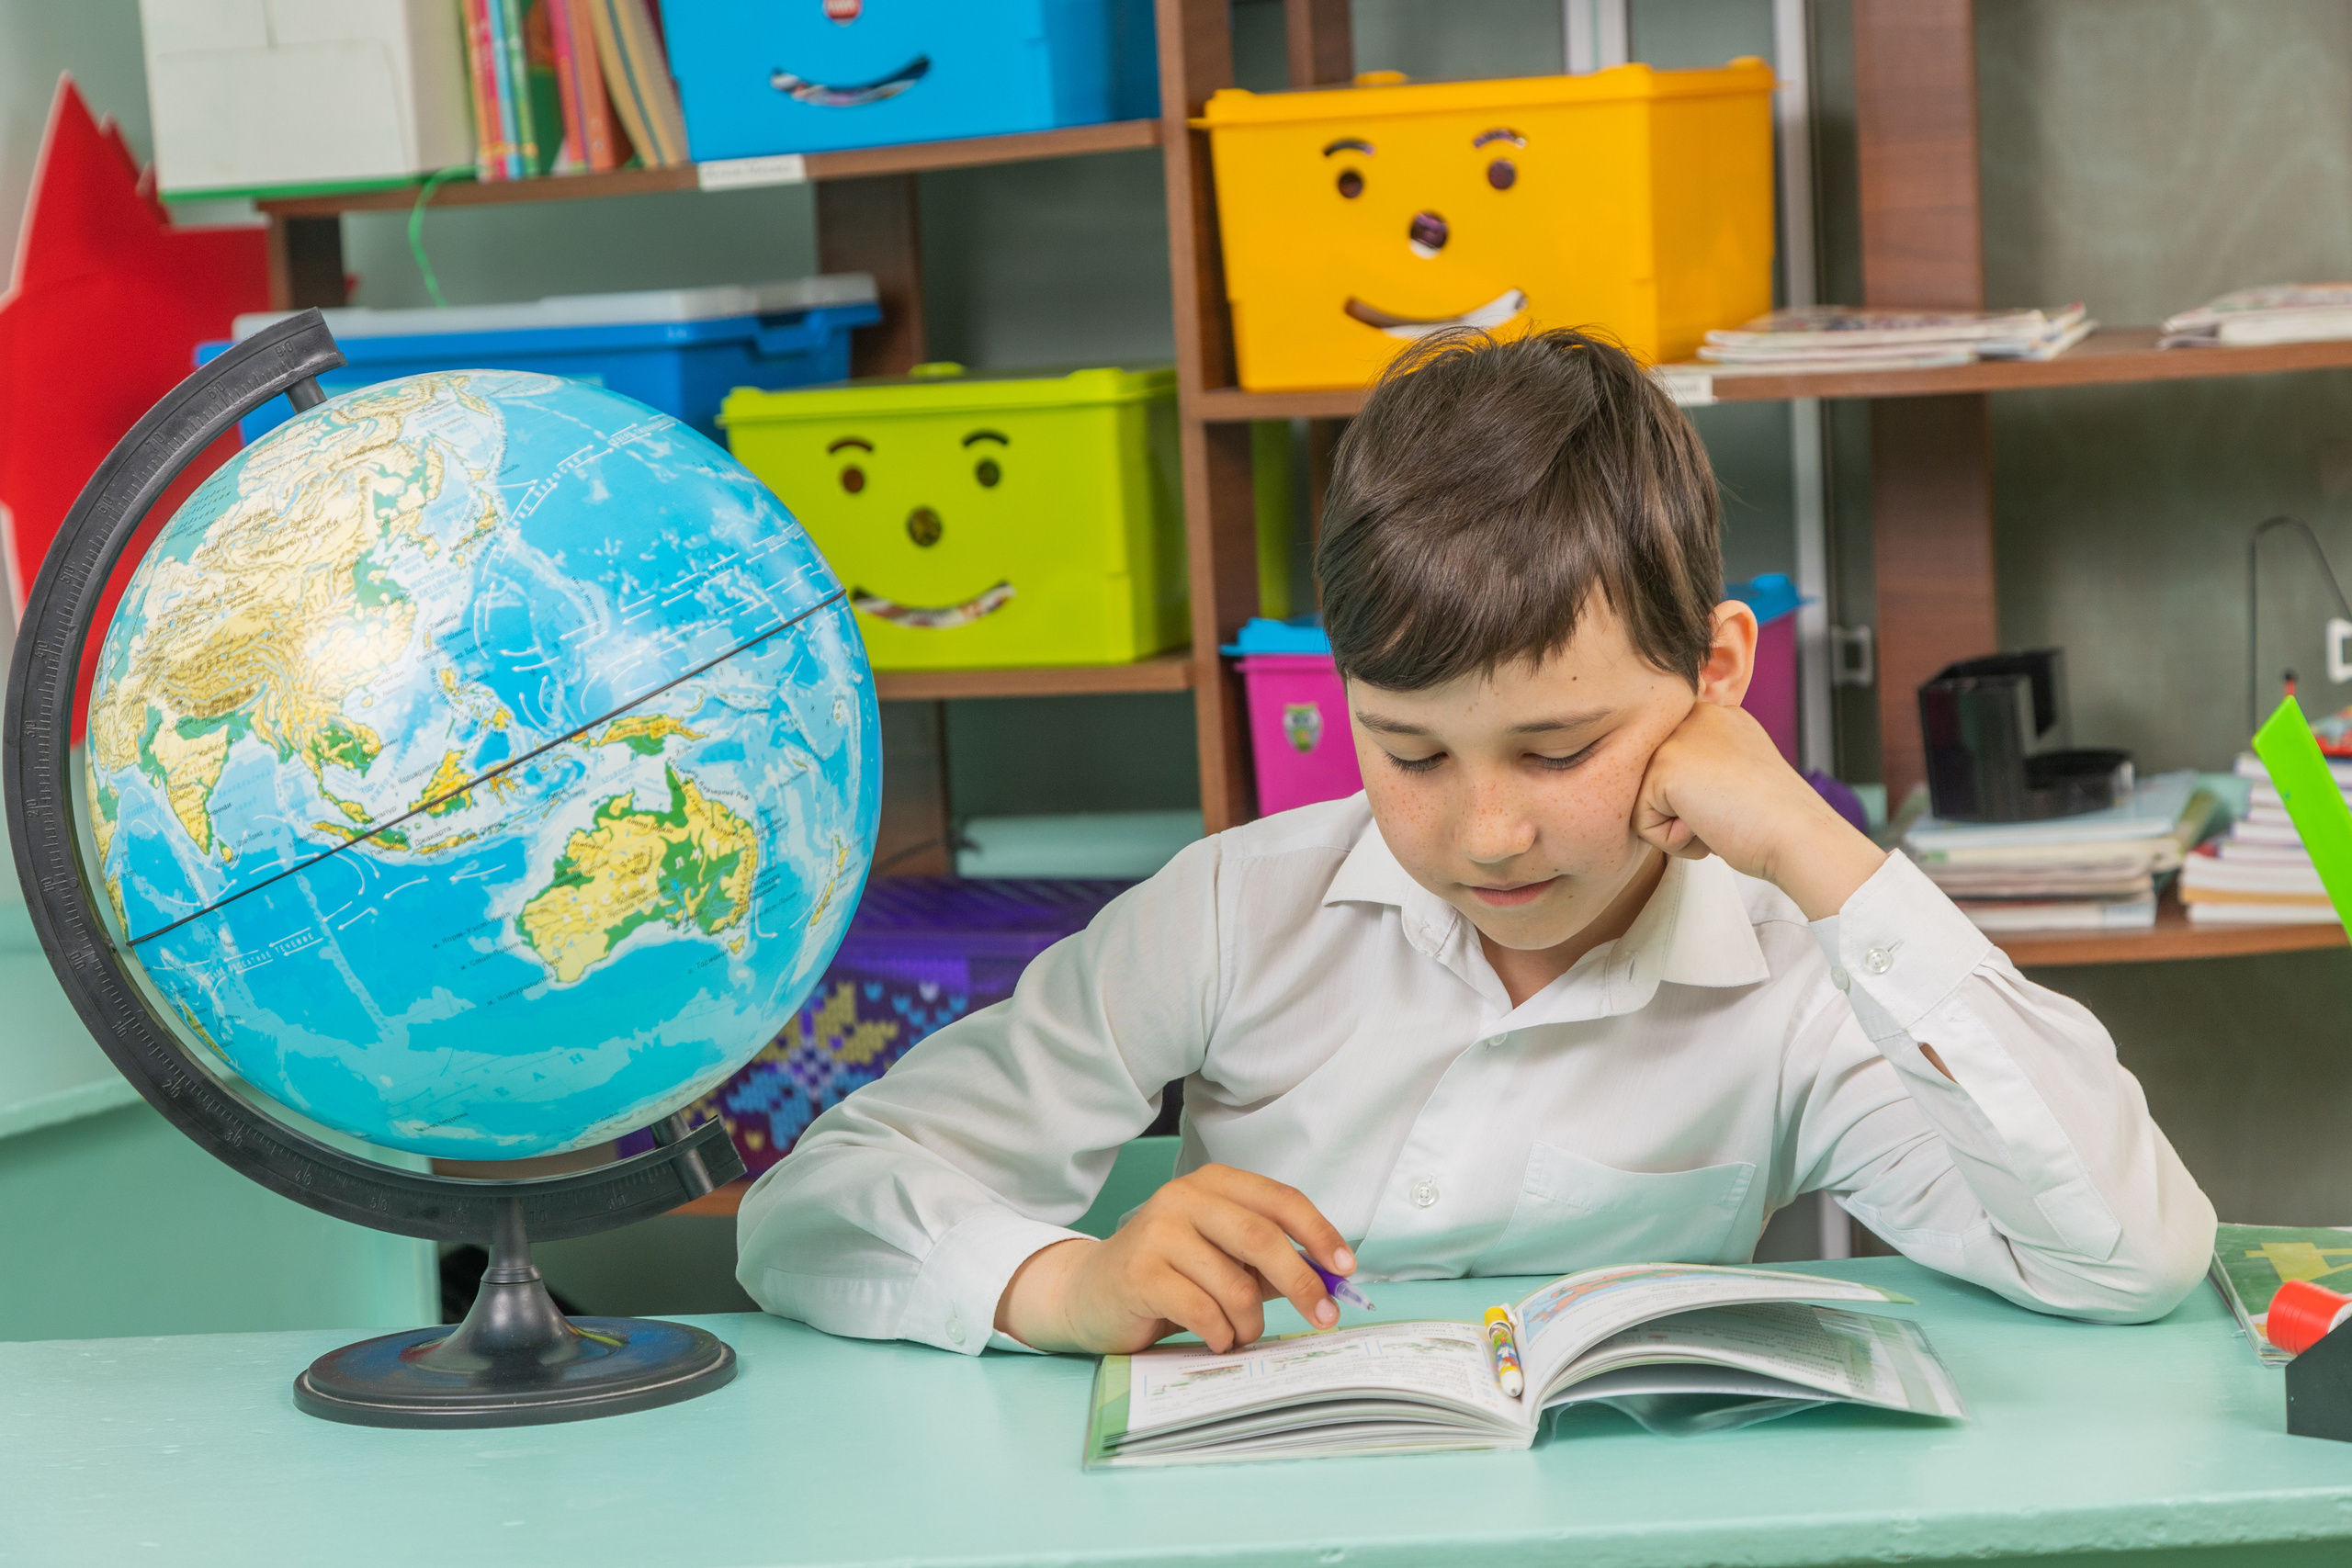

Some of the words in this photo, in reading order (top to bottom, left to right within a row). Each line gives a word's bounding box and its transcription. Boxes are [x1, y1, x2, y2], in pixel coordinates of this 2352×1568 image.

[377, 499, 430, 528] Владивосток
[59, 562, 75, 584] 50
[34, 640, 50, 660] 40
[397, 761, 439, 785] Калимантан
[26, 798, 40, 818] 20
[414, 826, 452, 847] Джакарта
[540, 954, 564, 969] Перт
[695, 948, 729, 970] Тасмания
[497, 973, 554, 1002] Натуралиста
[162, 1078, 182, 1099] 20
[224, 1131, 244, 1148] 30
[295, 1169, 314, 1186] 40
